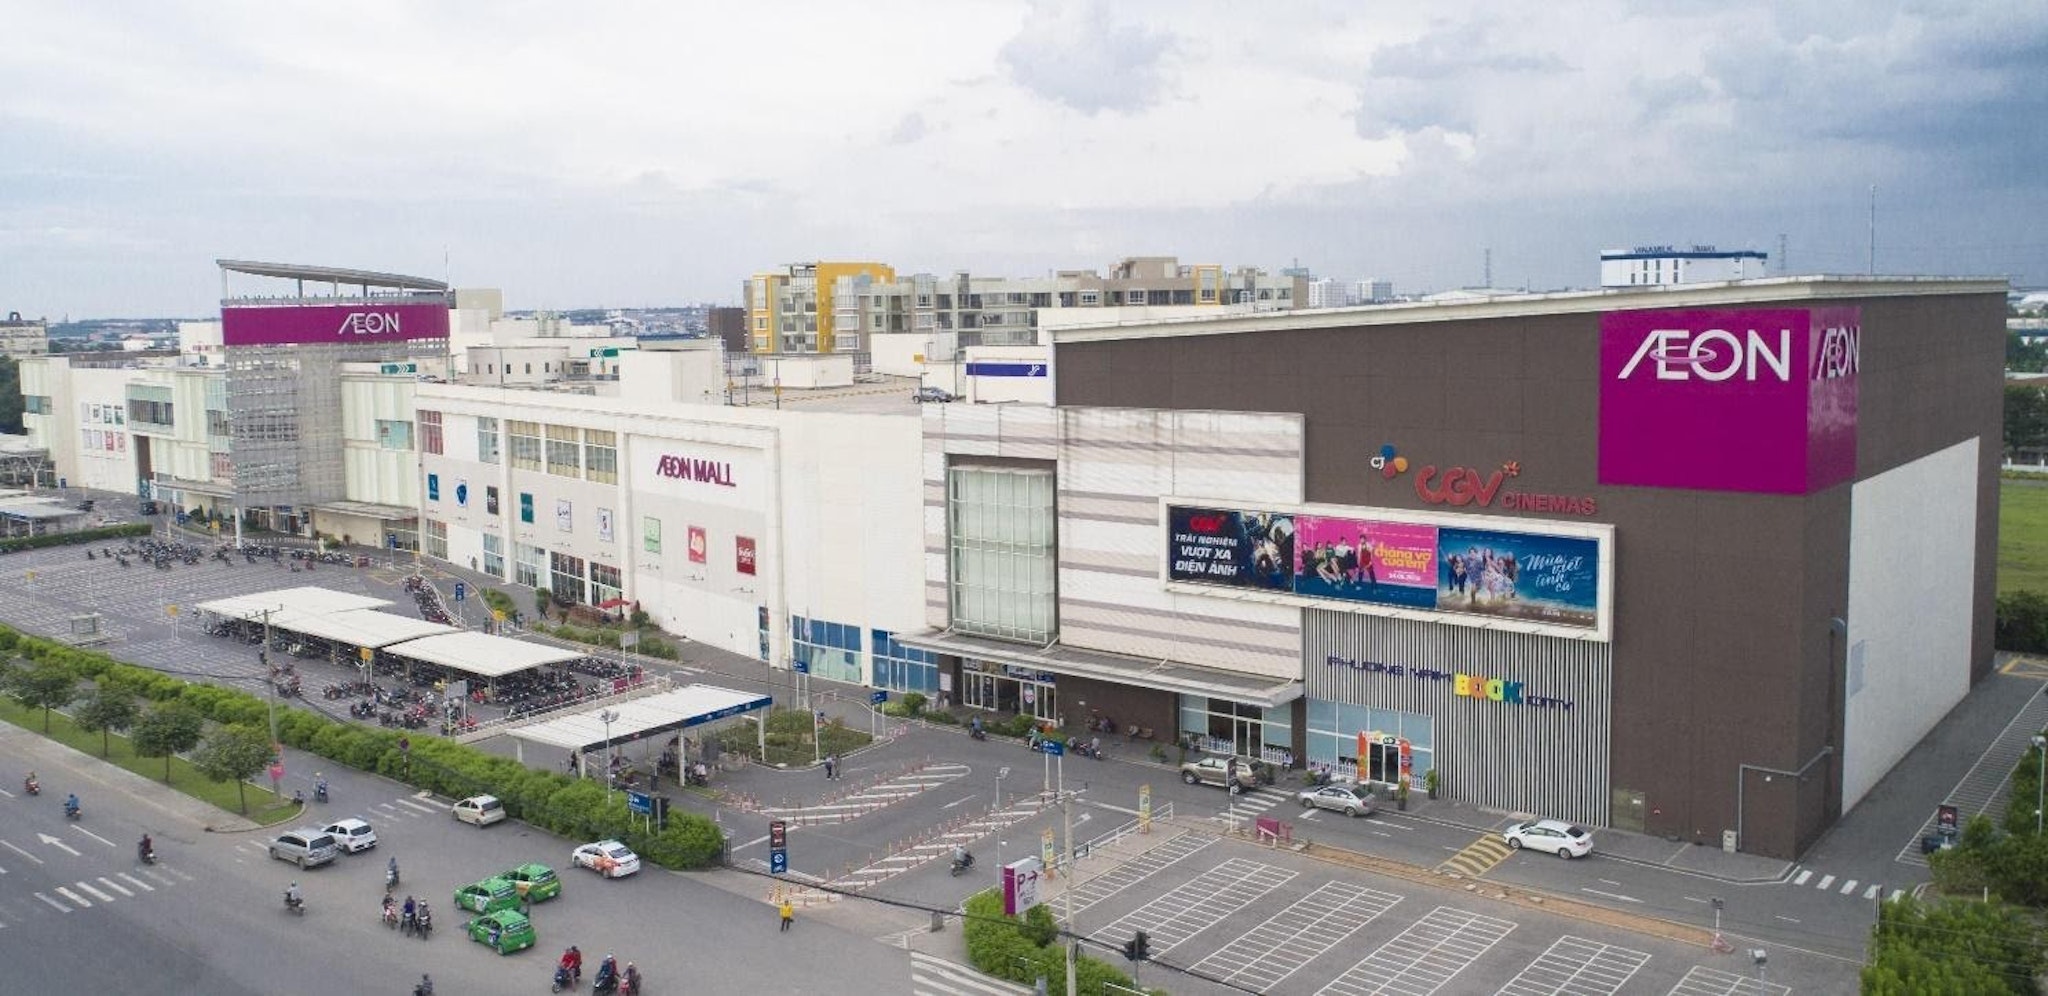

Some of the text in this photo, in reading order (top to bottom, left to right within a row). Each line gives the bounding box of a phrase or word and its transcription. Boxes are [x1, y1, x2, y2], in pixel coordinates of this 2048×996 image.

[693, 459, 737, 487] MALL
[1415, 465, 1504, 507] CGV
[1503, 491, 1598, 515] CINEMAS
[1214, 548, 1232, 560] XA
[1455, 672, 1524, 705] BOOK
